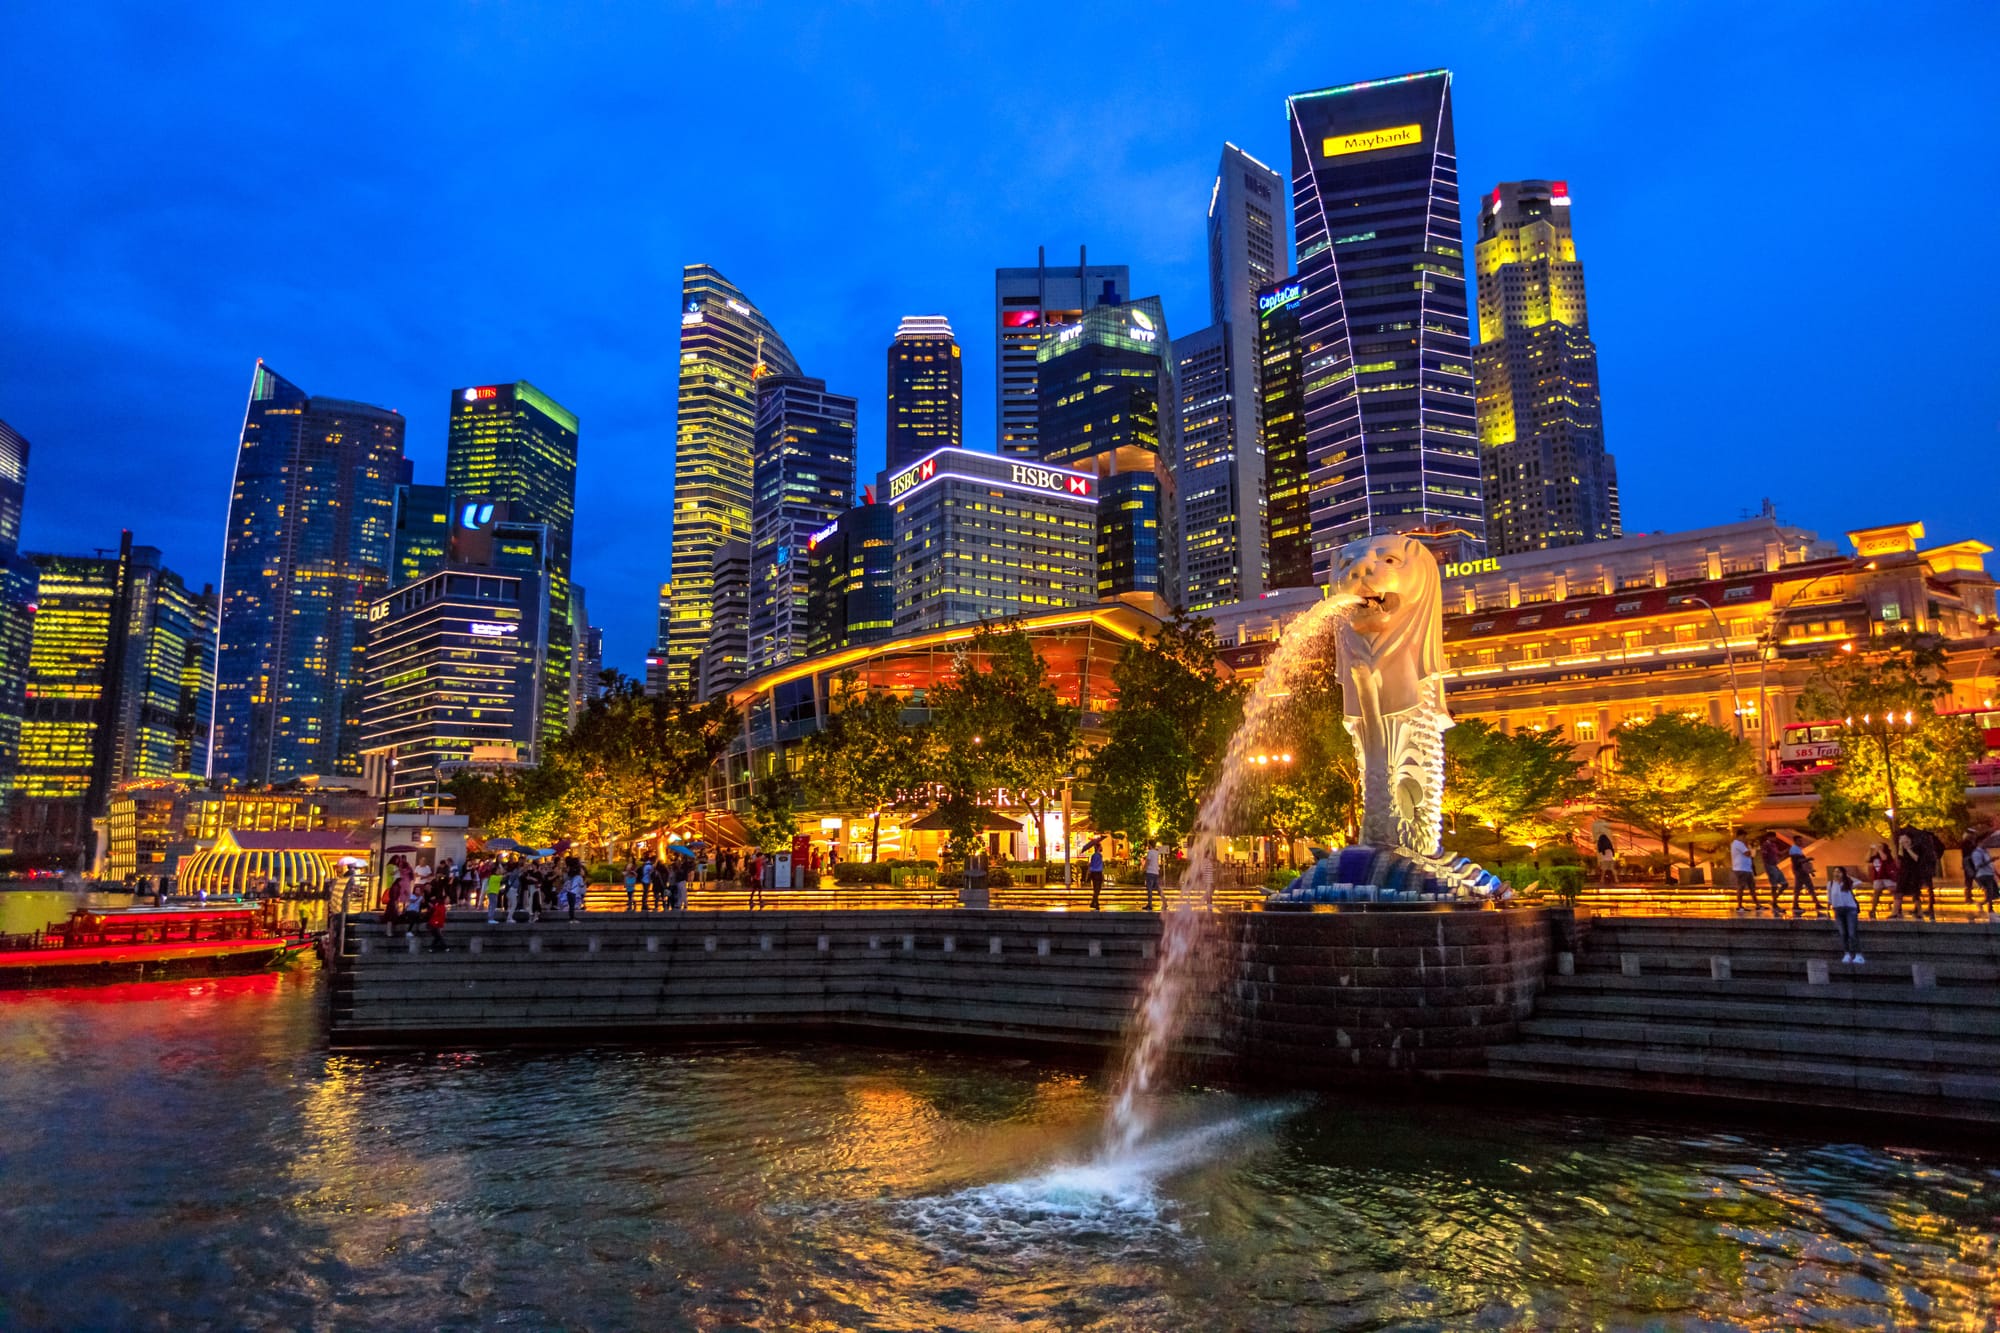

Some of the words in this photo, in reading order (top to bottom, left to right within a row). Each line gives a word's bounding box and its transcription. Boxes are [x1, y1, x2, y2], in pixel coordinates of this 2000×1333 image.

[1344, 130, 1411, 149] Maybank
[1060, 324, 1083, 342] MYP
[1130, 328, 1155, 342] MYP
[478, 390, 496, 399] UBS
[890, 465, 920, 499] HSBC
[1011, 464, 1063, 490] HSBC
[1445, 557, 1501, 578] HOTEL
[370, 601, 390, 622] OUE
[1795, 748, 1813, 757] SBS
[1814, 745, 1842, 757] Tran
[936, 784, 1056, 806] FLERON
